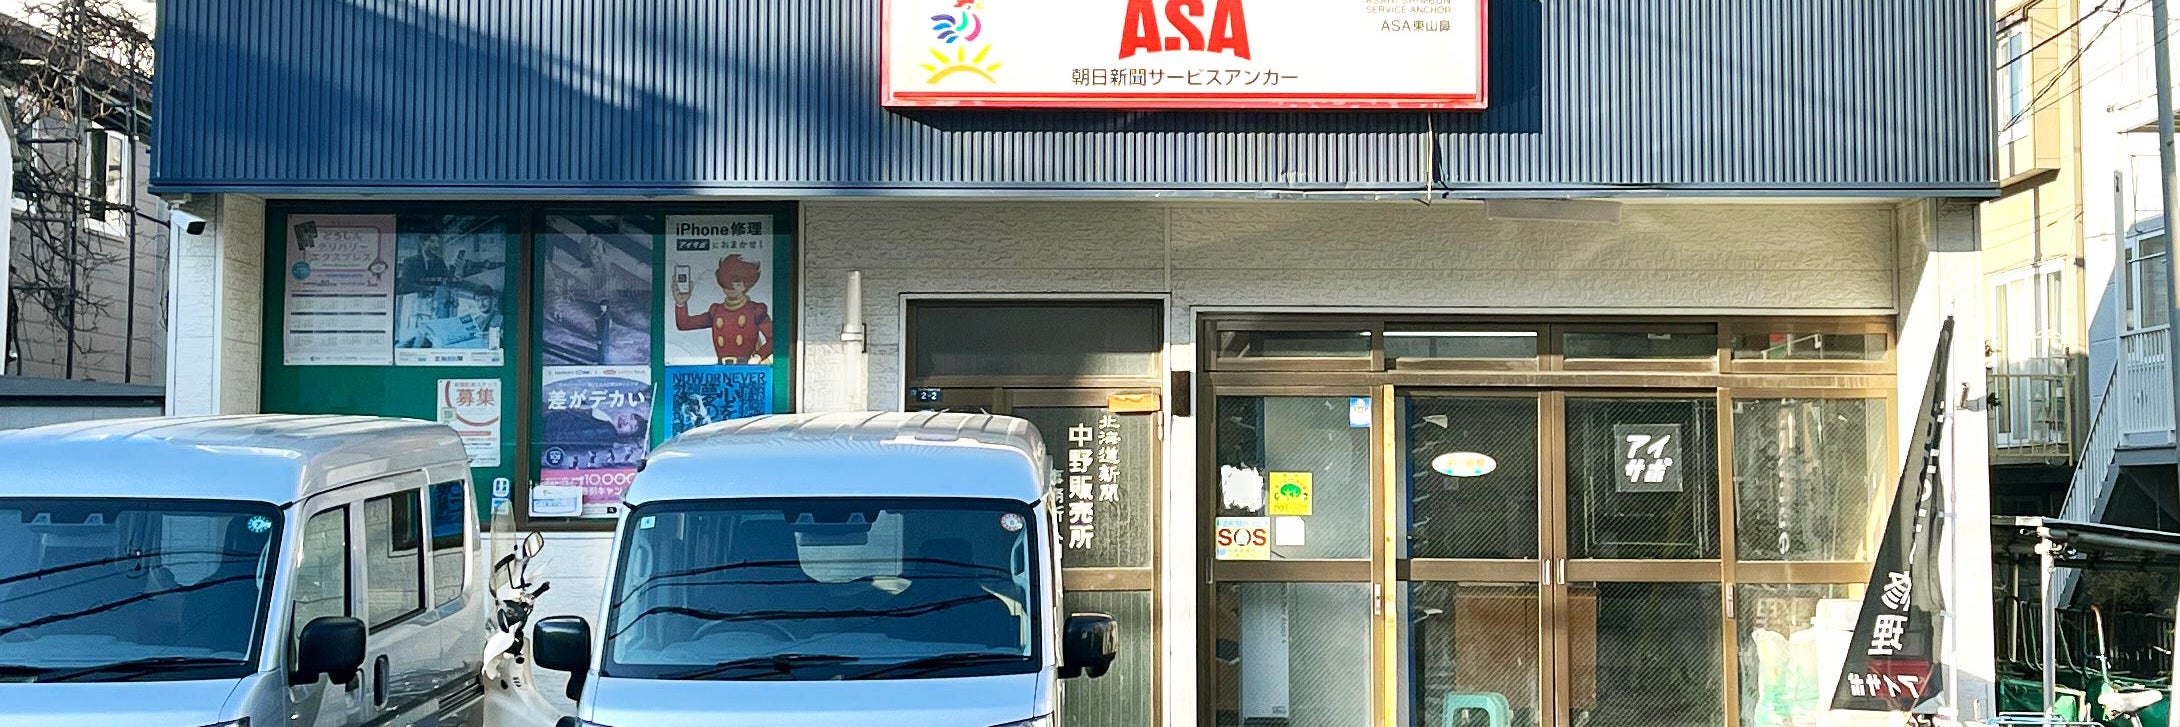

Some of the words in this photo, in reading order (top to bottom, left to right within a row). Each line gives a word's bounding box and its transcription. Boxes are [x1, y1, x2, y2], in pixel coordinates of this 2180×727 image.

[1366, 6, 1406, 14] SERVICE
[1410, 6, 1451, 14] ANCHOR
[1119, 0, 1252, 60] ASA
[1072, 68, 1299, 87] 朝日新聞サービスアンカー
[722, 372, 766, 384] NEVER
[456, 388, 496, 406] 募集
[548, 389, 645, 410] 差がデカい
[1626, 434, 1671, 459] アイ
[1099, 414, 1121, 503] 北海道新聞
[1625, 458, 1673, 483] サポ
[1068, 422, 1095, 550] 中野販売所
[1217, 528, 1267, 547] SOS
